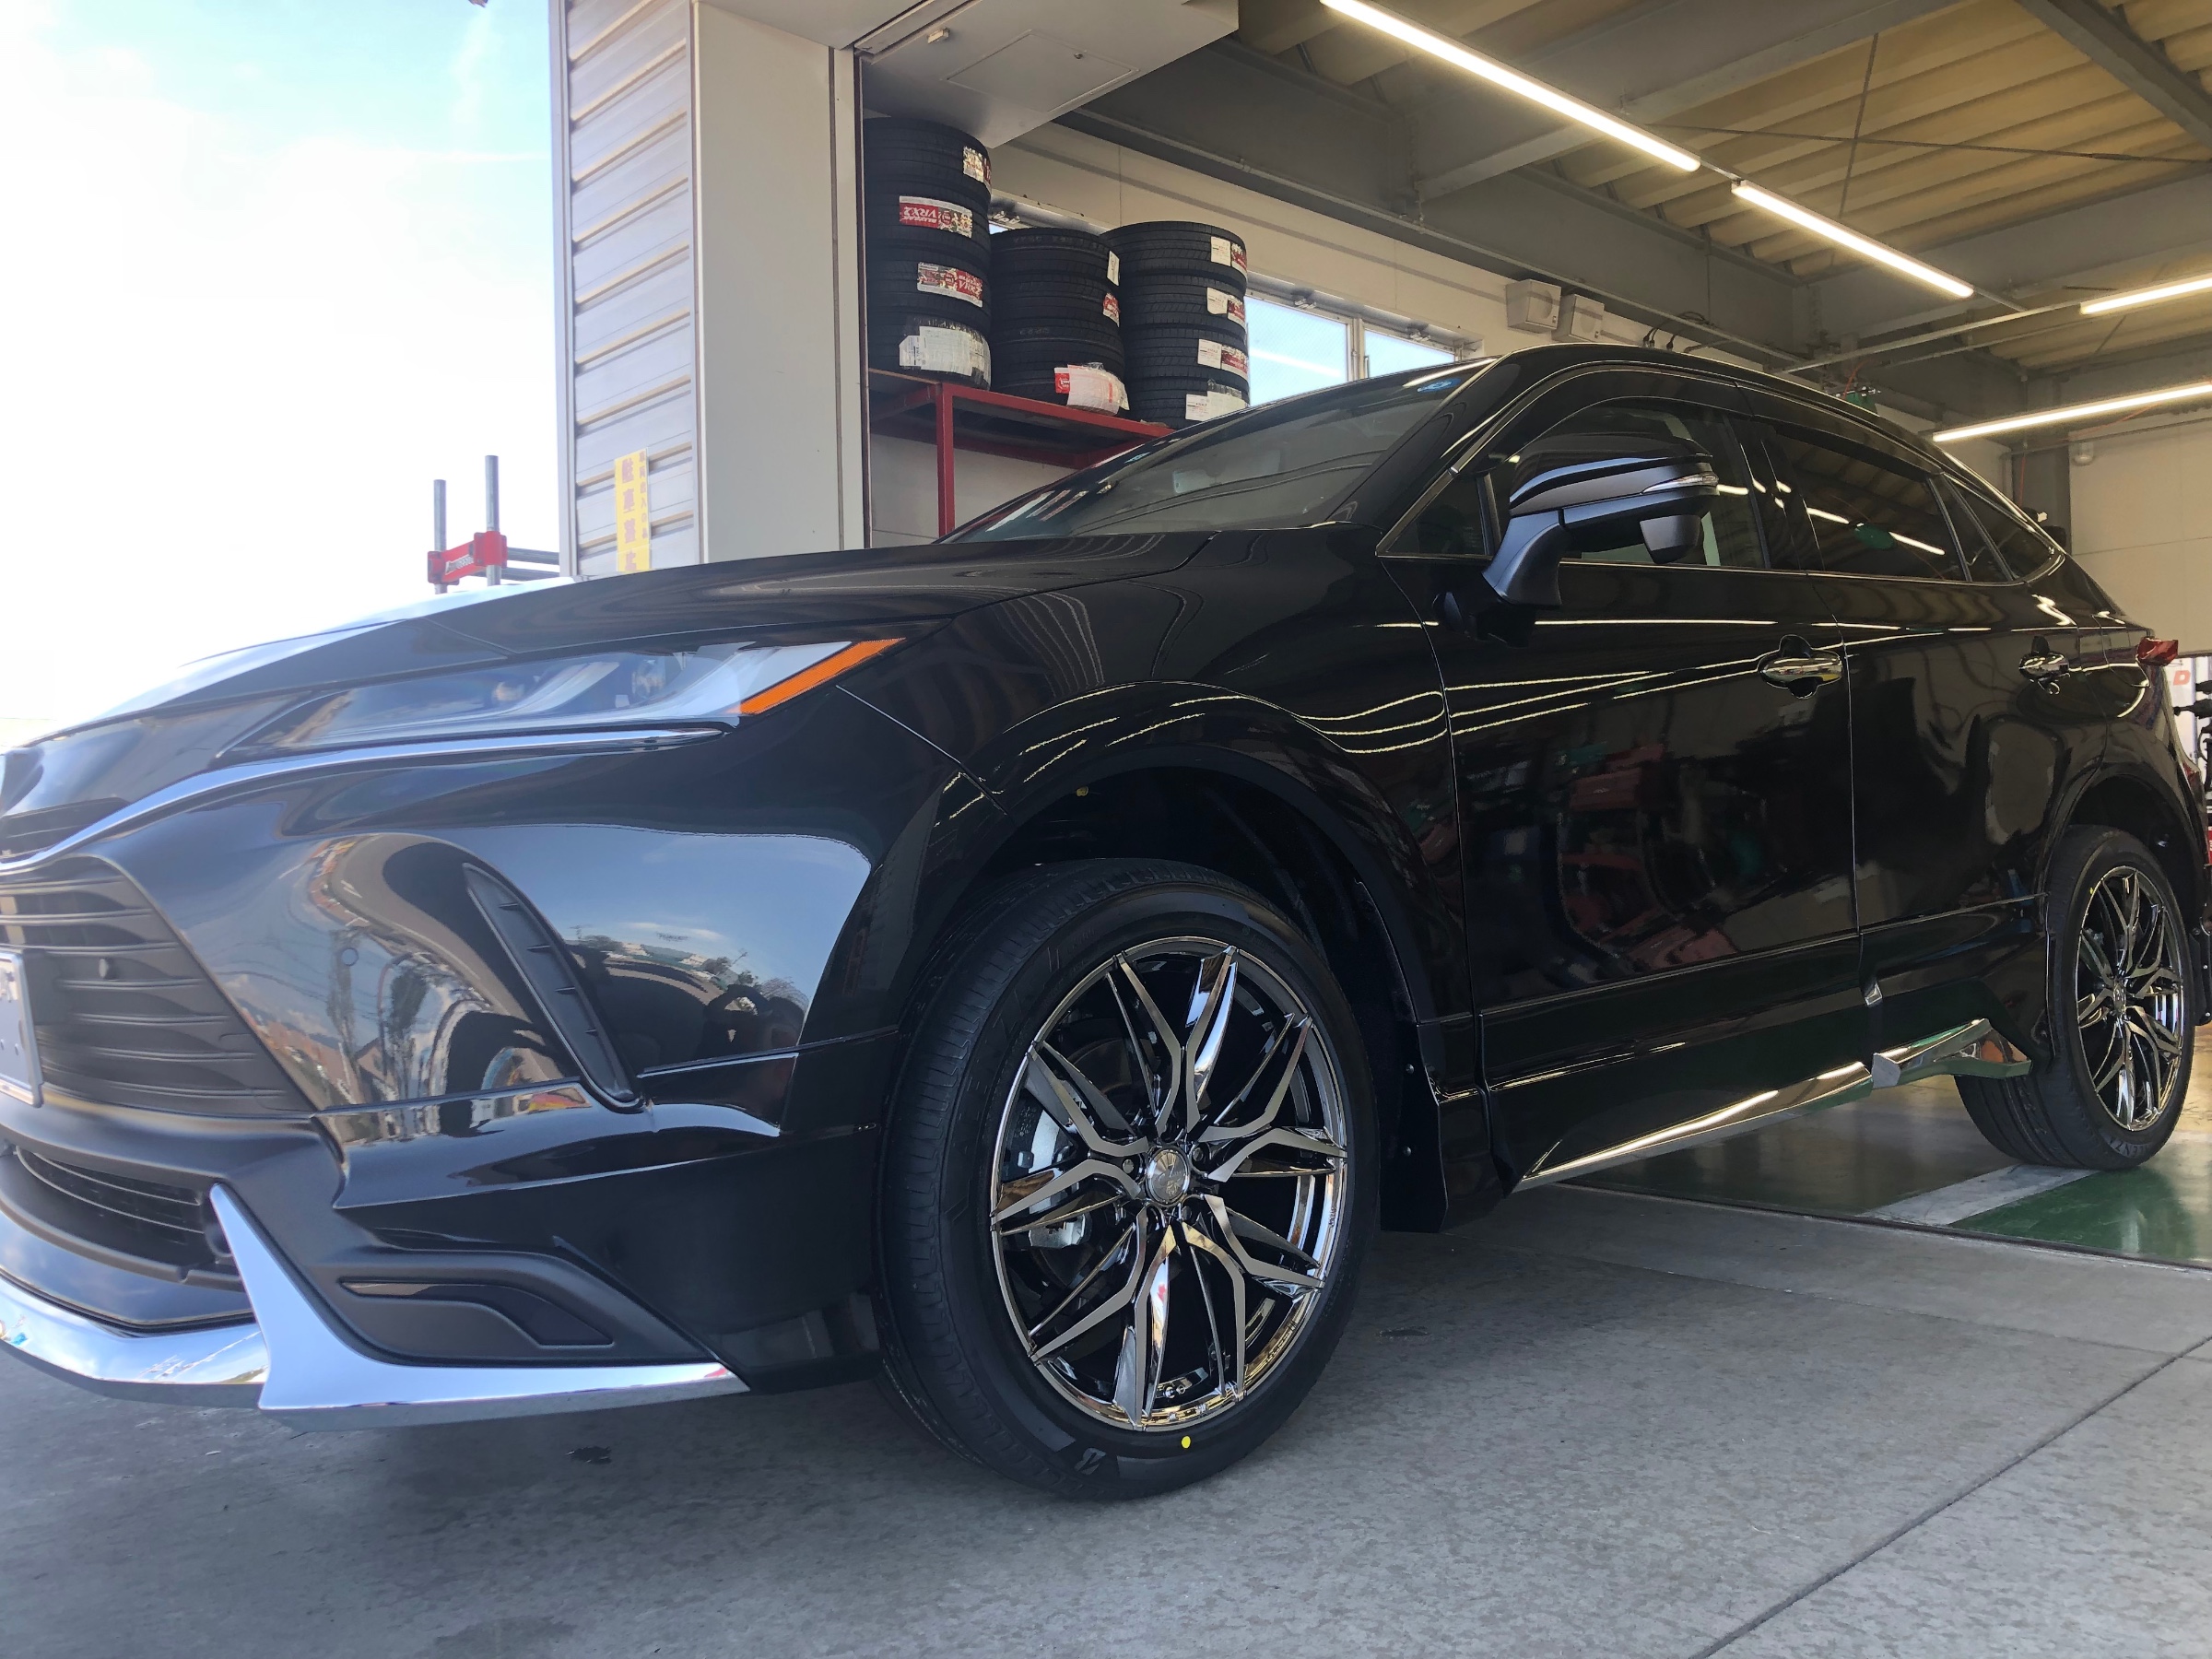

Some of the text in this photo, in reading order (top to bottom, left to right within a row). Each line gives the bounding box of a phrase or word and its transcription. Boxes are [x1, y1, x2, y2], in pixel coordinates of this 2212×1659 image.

[903, 206, 936, 218] VRX2
[621, 457, 637, 571] 駐車禁止
